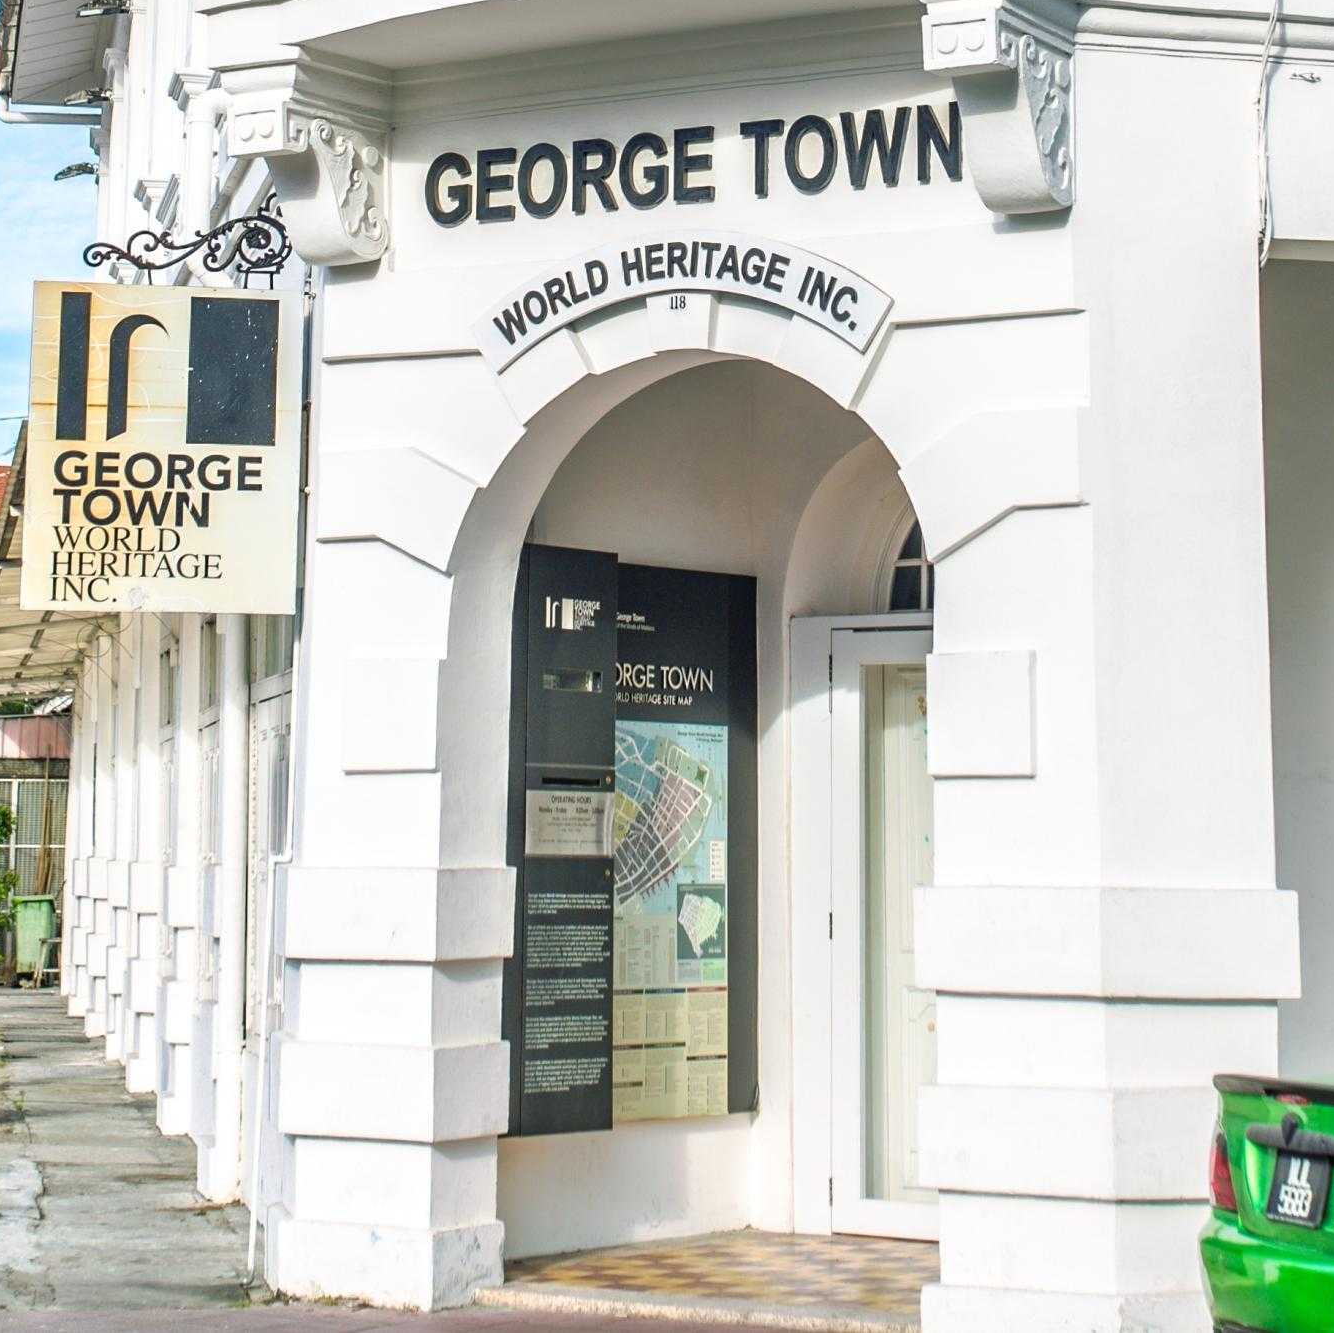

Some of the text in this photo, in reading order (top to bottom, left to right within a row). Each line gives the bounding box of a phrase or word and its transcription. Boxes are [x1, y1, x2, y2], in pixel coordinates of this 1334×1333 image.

[424, 101, 963, 228] GEORGE TOWN
[492, 240, 858, 345] WORLD HERITAGE INC.
[670, 295, 686, 310] 118
[53, 449, 263, 491] GEORGE
[52, 488, 210, 528] TOWN
[51, 525, 181, 553] WORLD
[50, 551, 223, 579] HERITAGE
[49, 576, 117, 603] INC.
[660, 666, 713, 693] TOWN
[631, 693, 662, 705] HERITAGE
[663, 695, 676, 706] SITE
[677, 696, 693, 706] MAP
